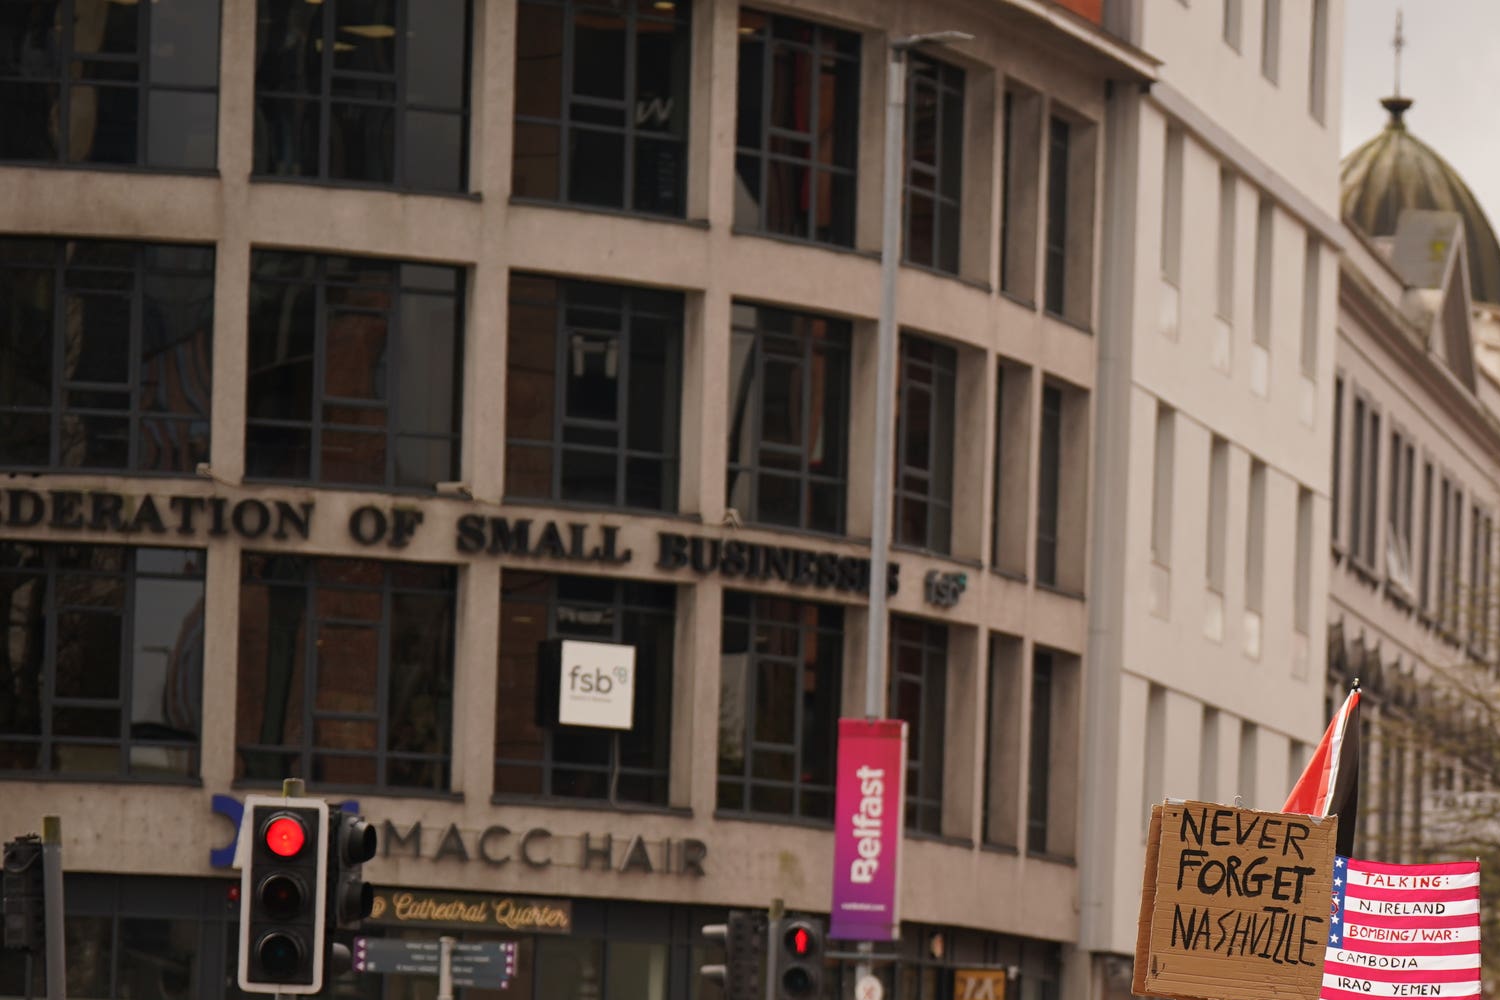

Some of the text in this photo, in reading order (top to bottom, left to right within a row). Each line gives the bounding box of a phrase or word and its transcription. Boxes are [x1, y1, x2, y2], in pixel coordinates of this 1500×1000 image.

[0, 489, 314, 539] DERATION
[349, 505, 424, 548] OF
[456, 515, 631, 564] SMALL
[568, 664, 613, 694] fsb
[850, 765, 885, 884] Belfast
[1180, 808, 1310, 860] NEVER
[383, 819, 709, 877] MACC HAIR
[1177, 849, 1316, 905] FORGET
[1361, 872, 1450, 888] TALKING:
[393, 892, 488, 923] Cathedral
[491, 898, 569, 931] Quarter
[1359, 900, 1446, 915] N. IRELAND
[1171, 904, 1325, 967] NASHVILLE
[1336, 951, 1419, 968] CAMBODIA
[1338, 977, 1441, 996] IRAQ YEMEN
